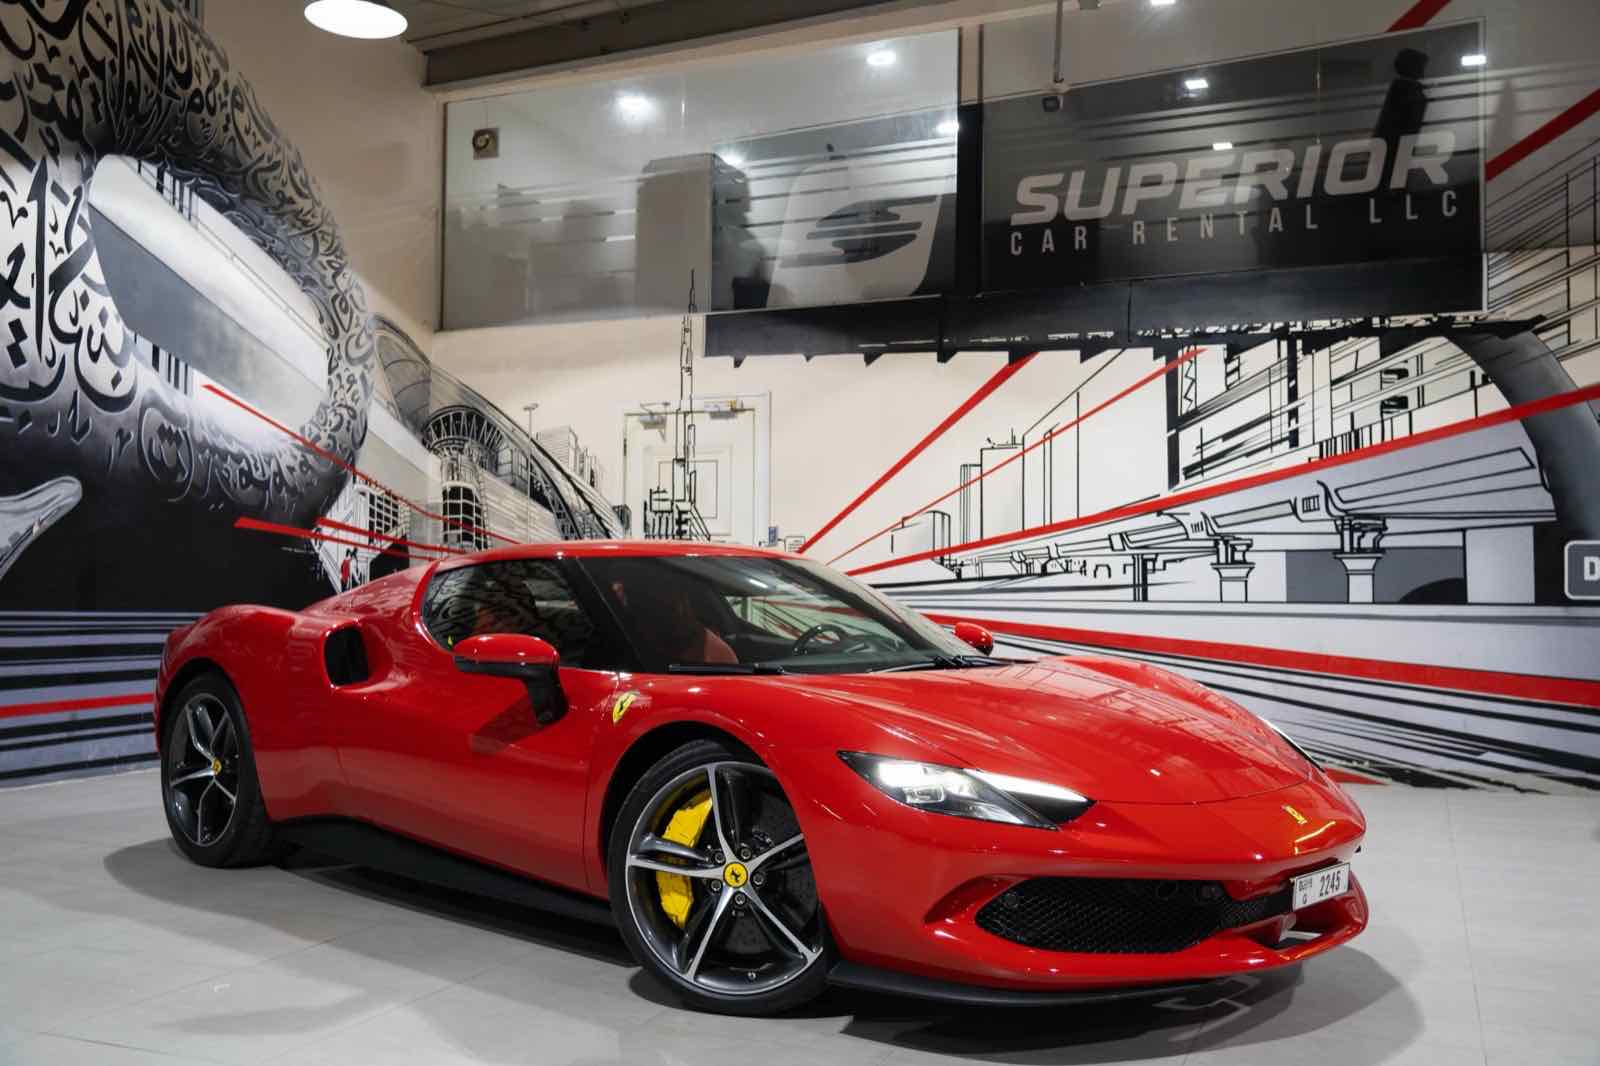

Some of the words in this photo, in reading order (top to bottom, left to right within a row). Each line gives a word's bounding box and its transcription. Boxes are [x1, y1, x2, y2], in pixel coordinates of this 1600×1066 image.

[1010, 130, 1455, 226] SUPERIOR
[1010, 225, 1087, 256] CAR
[1132, 205, 1319, 246] RENTAL
[1369, 190, 1457, 225] LLC
[1320, 871, 1340, 896] 2245
